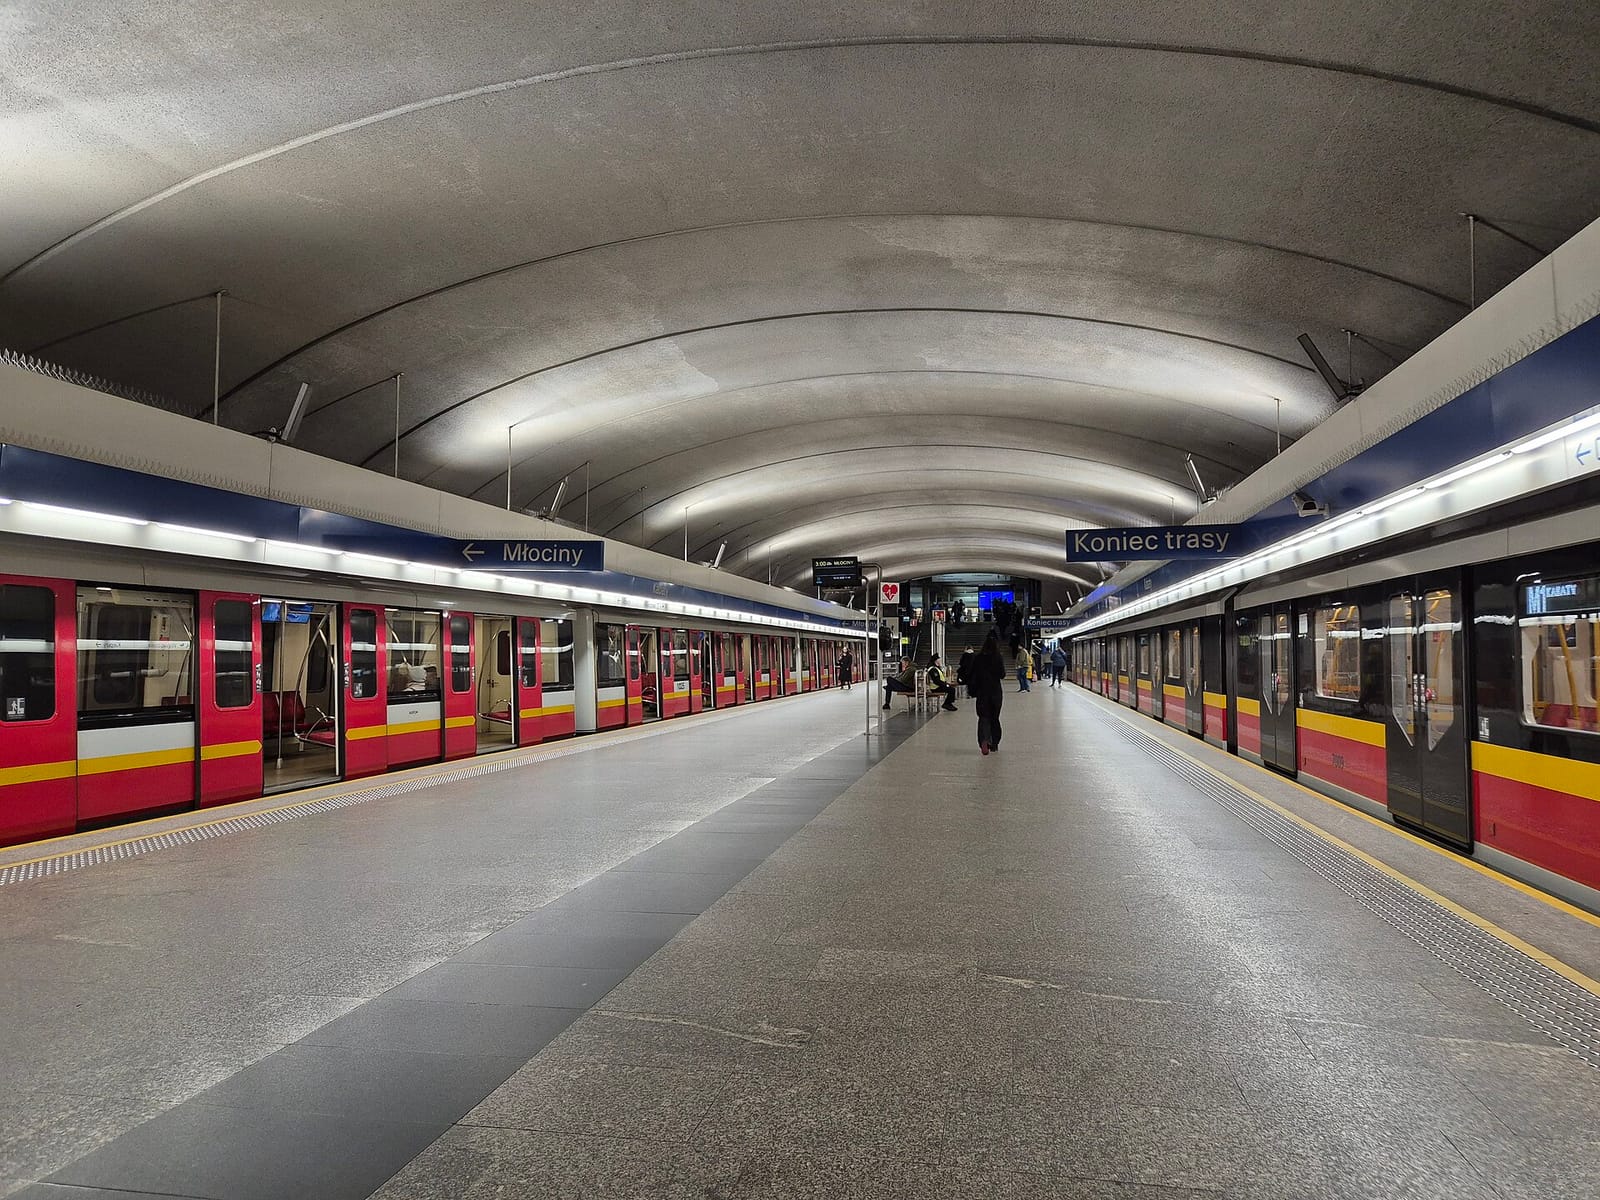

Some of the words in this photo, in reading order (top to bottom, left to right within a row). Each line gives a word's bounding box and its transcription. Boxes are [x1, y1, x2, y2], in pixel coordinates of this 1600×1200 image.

[1074, 531, 1159, 553] Koniec
[1165, 532, 1229, 552] trasy
[502, 543, 583, 567] Młociny
